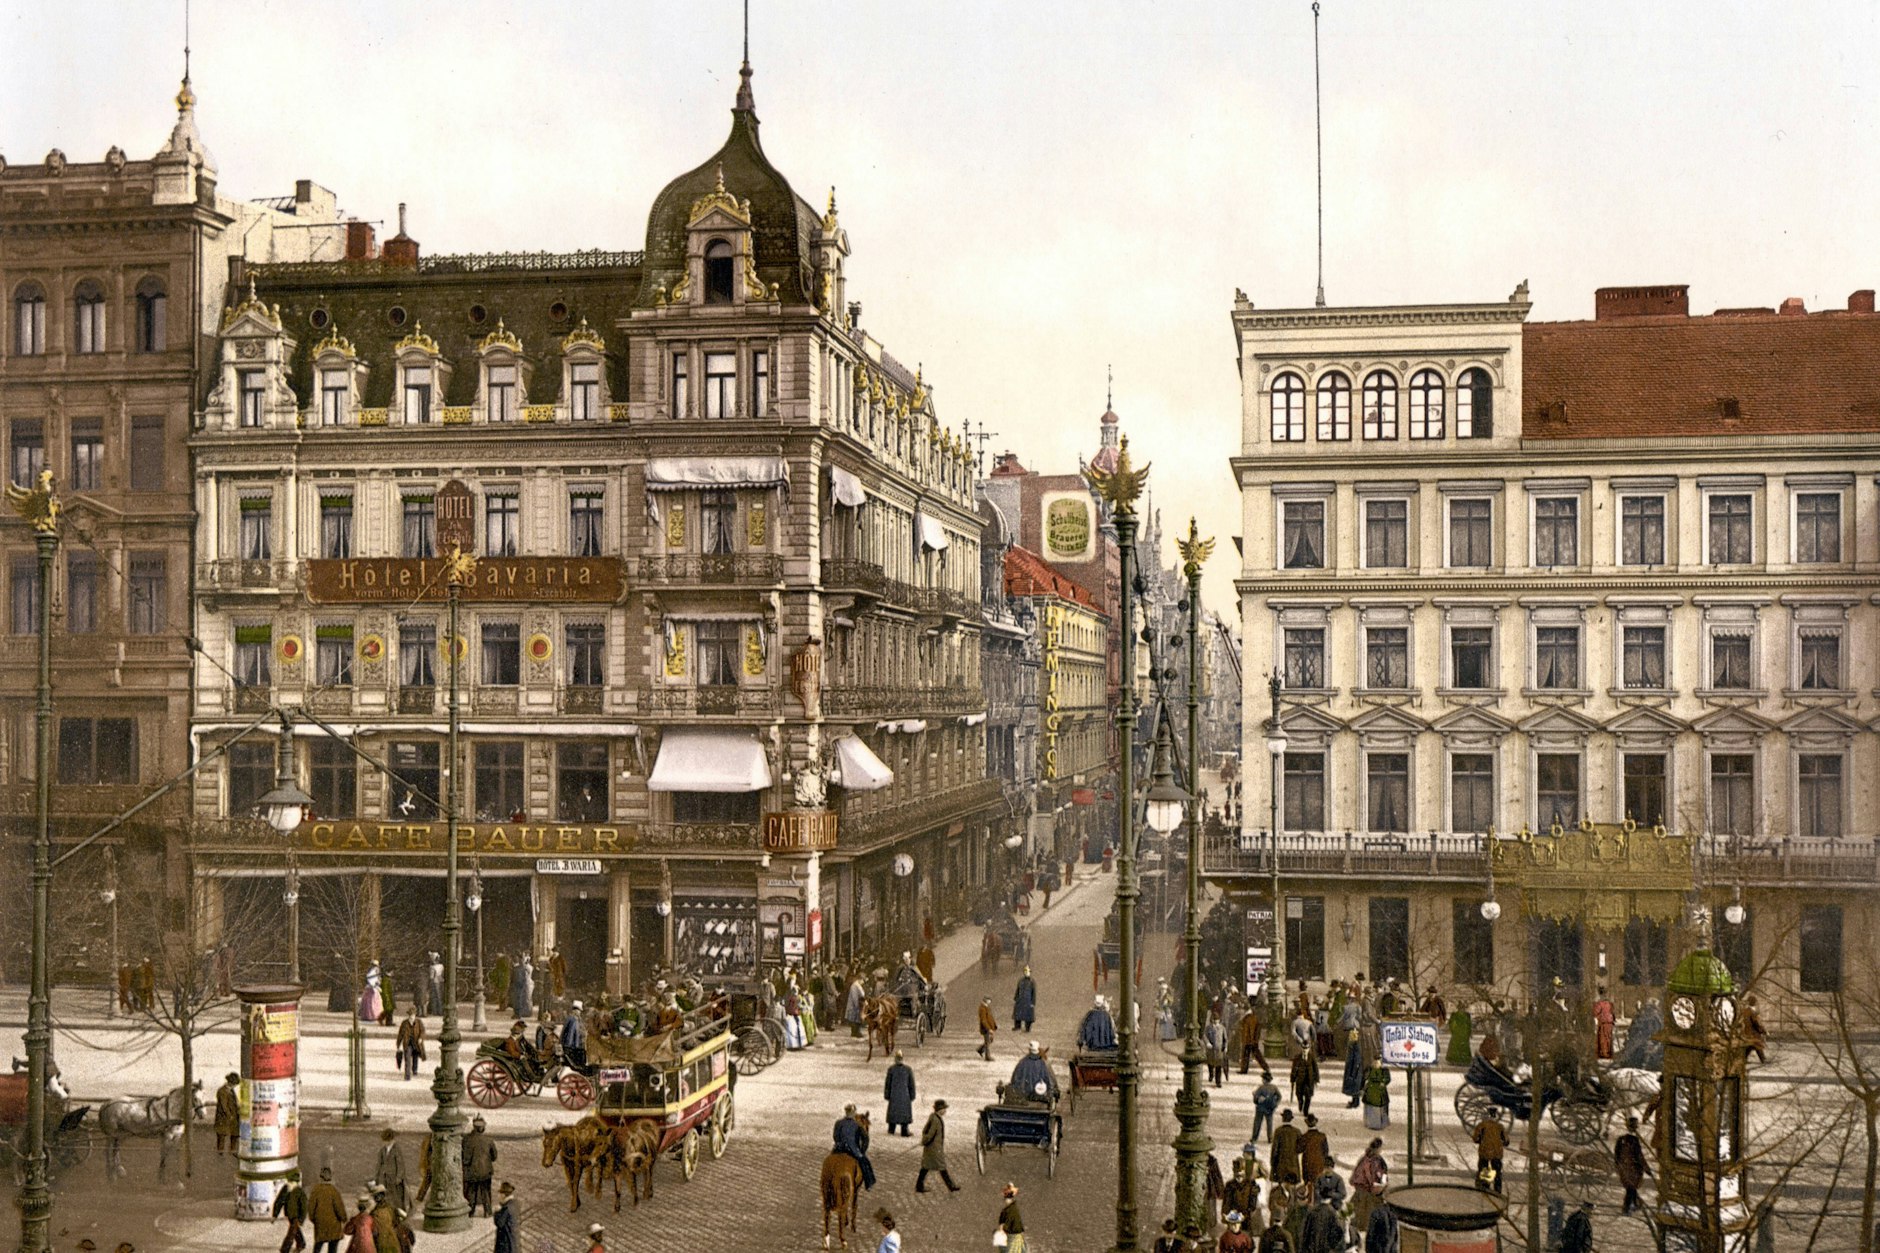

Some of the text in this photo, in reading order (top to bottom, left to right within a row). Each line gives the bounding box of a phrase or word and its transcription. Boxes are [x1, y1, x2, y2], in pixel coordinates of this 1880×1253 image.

[339, 561, 426, 589] Hôtel
[1046, 606, 1059, 778] REMINGTON
[312, 824, 432, 848] CAFE
[769, 817, 806, 847] CAFE
[1386, 1026, 1434, 1045] Unfall Station
